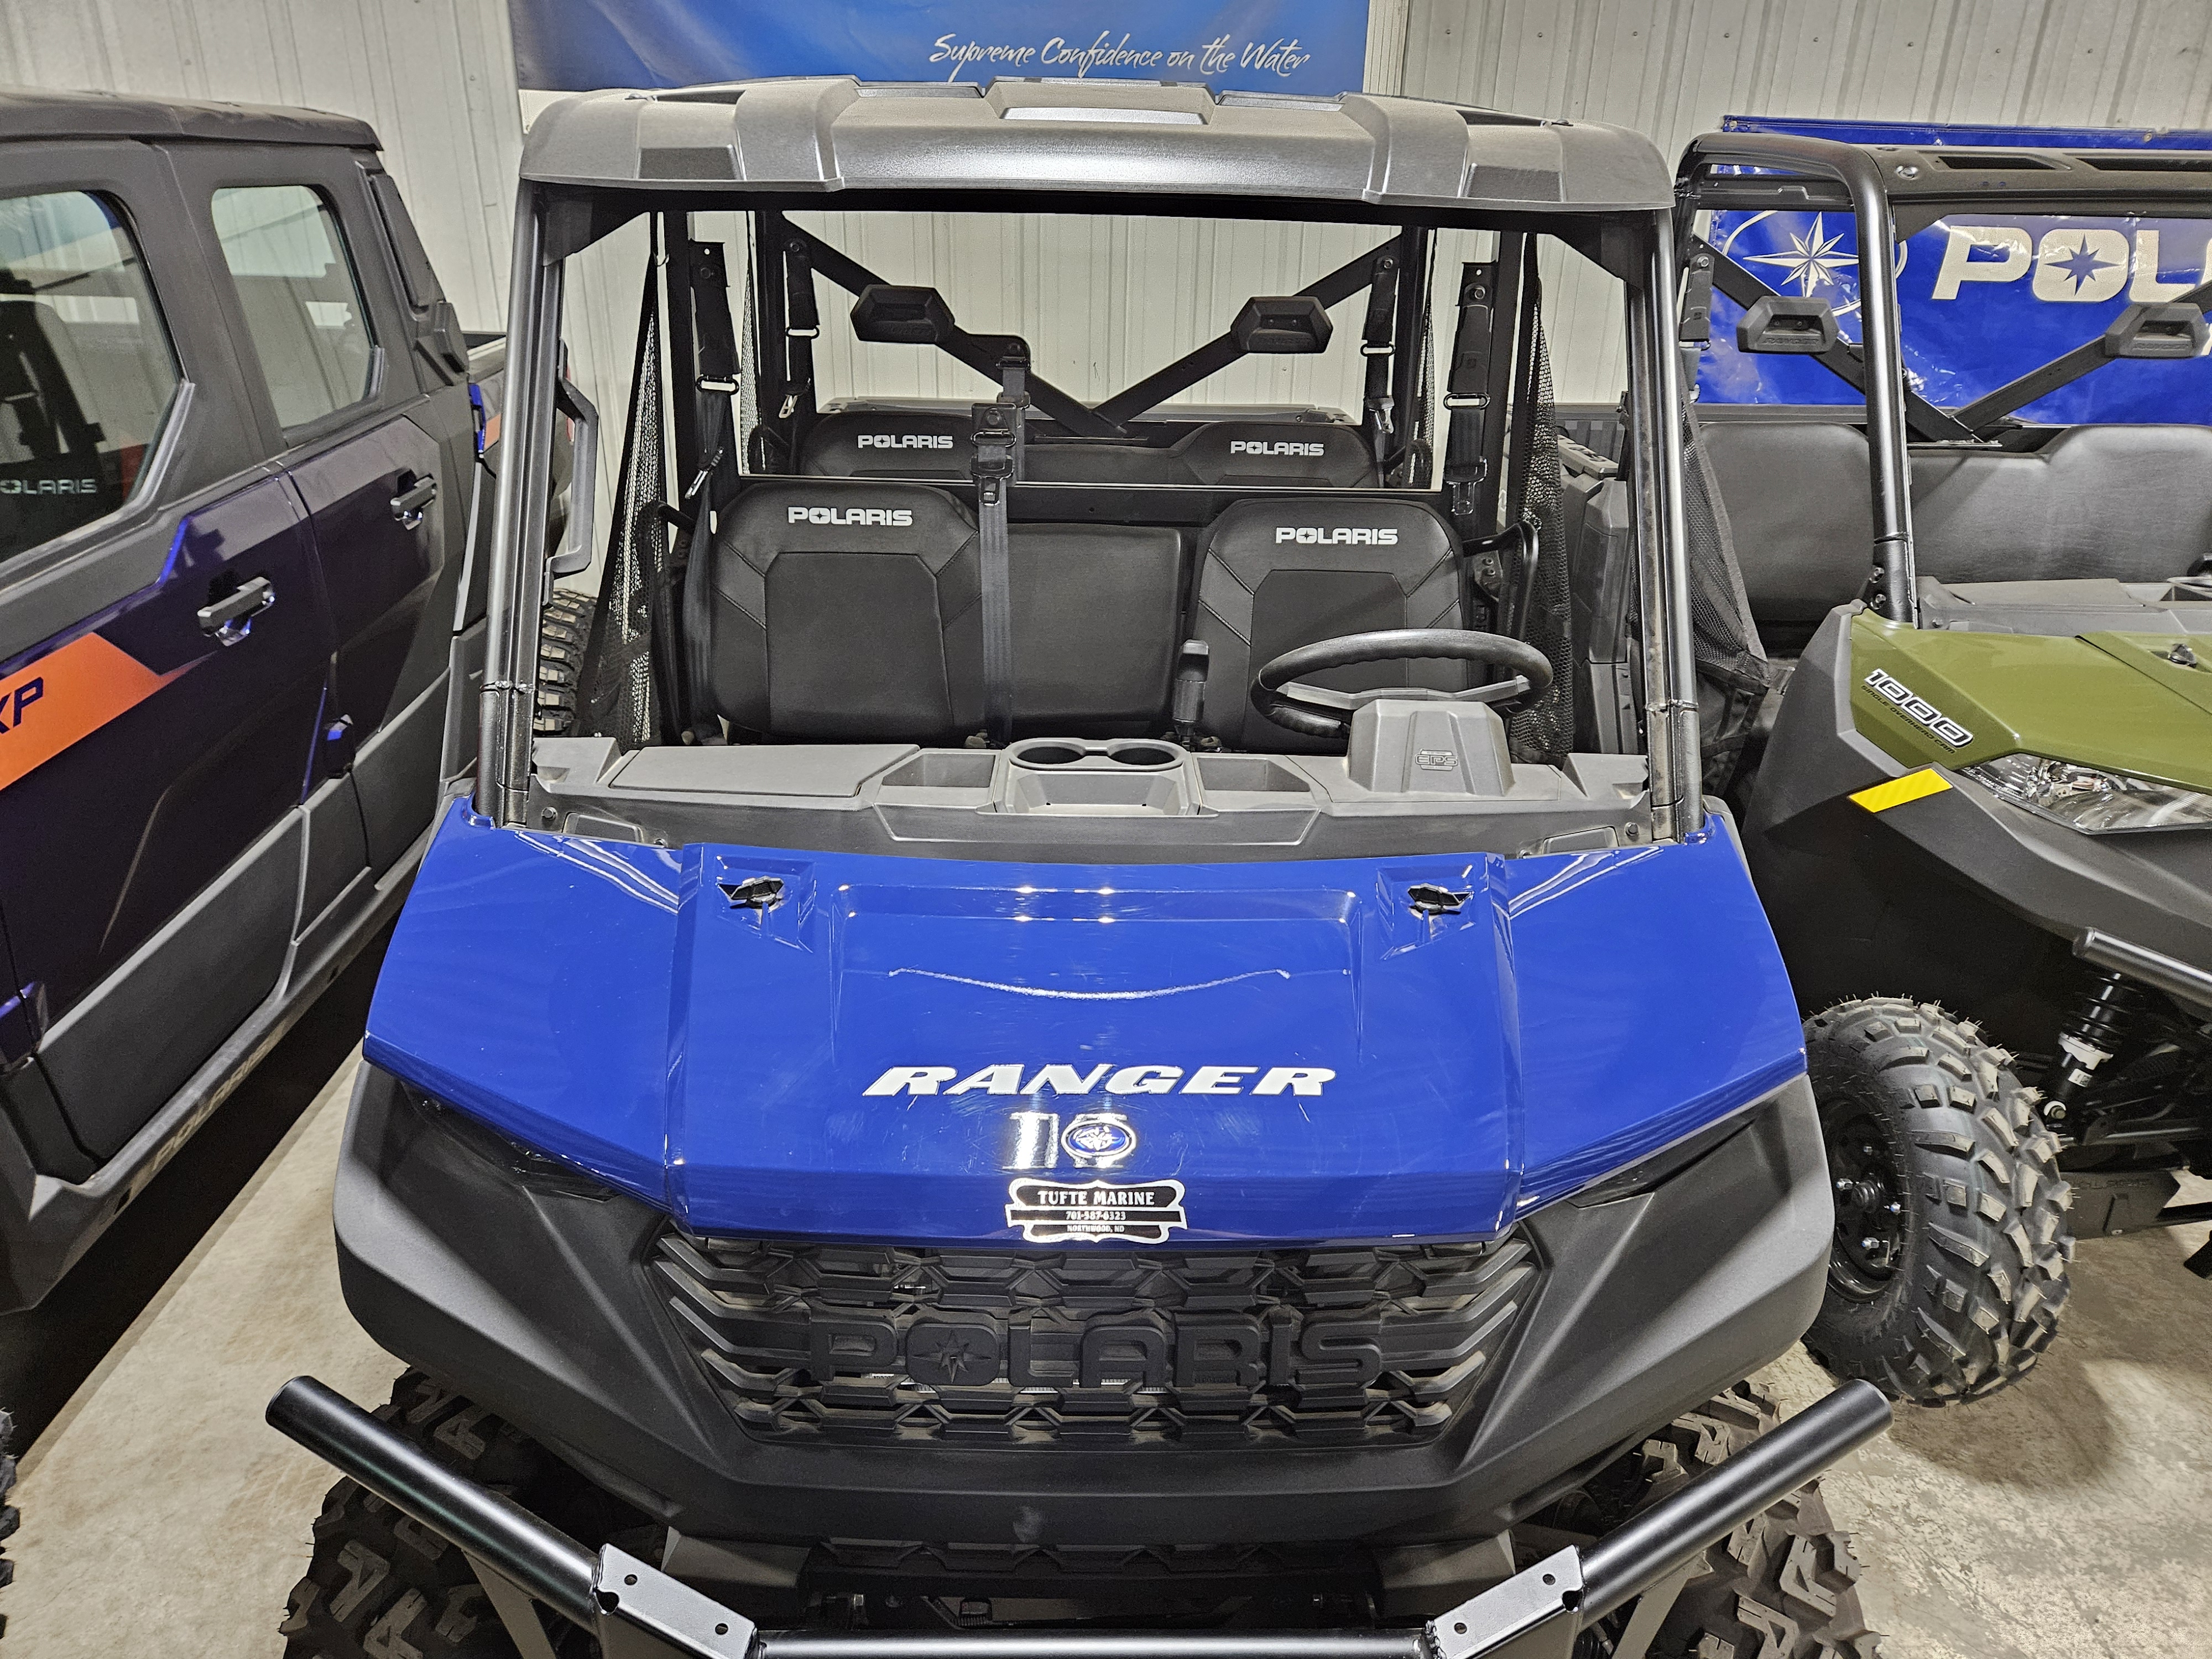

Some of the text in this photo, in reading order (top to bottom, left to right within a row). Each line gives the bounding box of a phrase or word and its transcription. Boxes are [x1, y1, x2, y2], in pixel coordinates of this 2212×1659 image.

[929, 30, 1311, 82] Supreme Confidence on the Water
[1932, 226, 2212, 302] POL
[858, 435, 953, 448] POLARIS
[1230, 441, 1324, 456] POLARIS
[788, 507, 912, 526] POLARIS
[1276, 527, 1398, 545] POLARIS
[1864, 668, 1974, 748] 1000
[1890, 707, 1934, 739] OVERHEAD
[1934, 739, 1957, 754] CAM
[1415, 754, 1458, 766] EPS
[862, 1064, 1337, 1097] RANGER
[1037, 1191, 1155, 1206] TUFTE MARINE
[1067, 1225, 1113, 1233] NORTHWOOD,
[810, 1318, 1381, 1387] POLARIS
